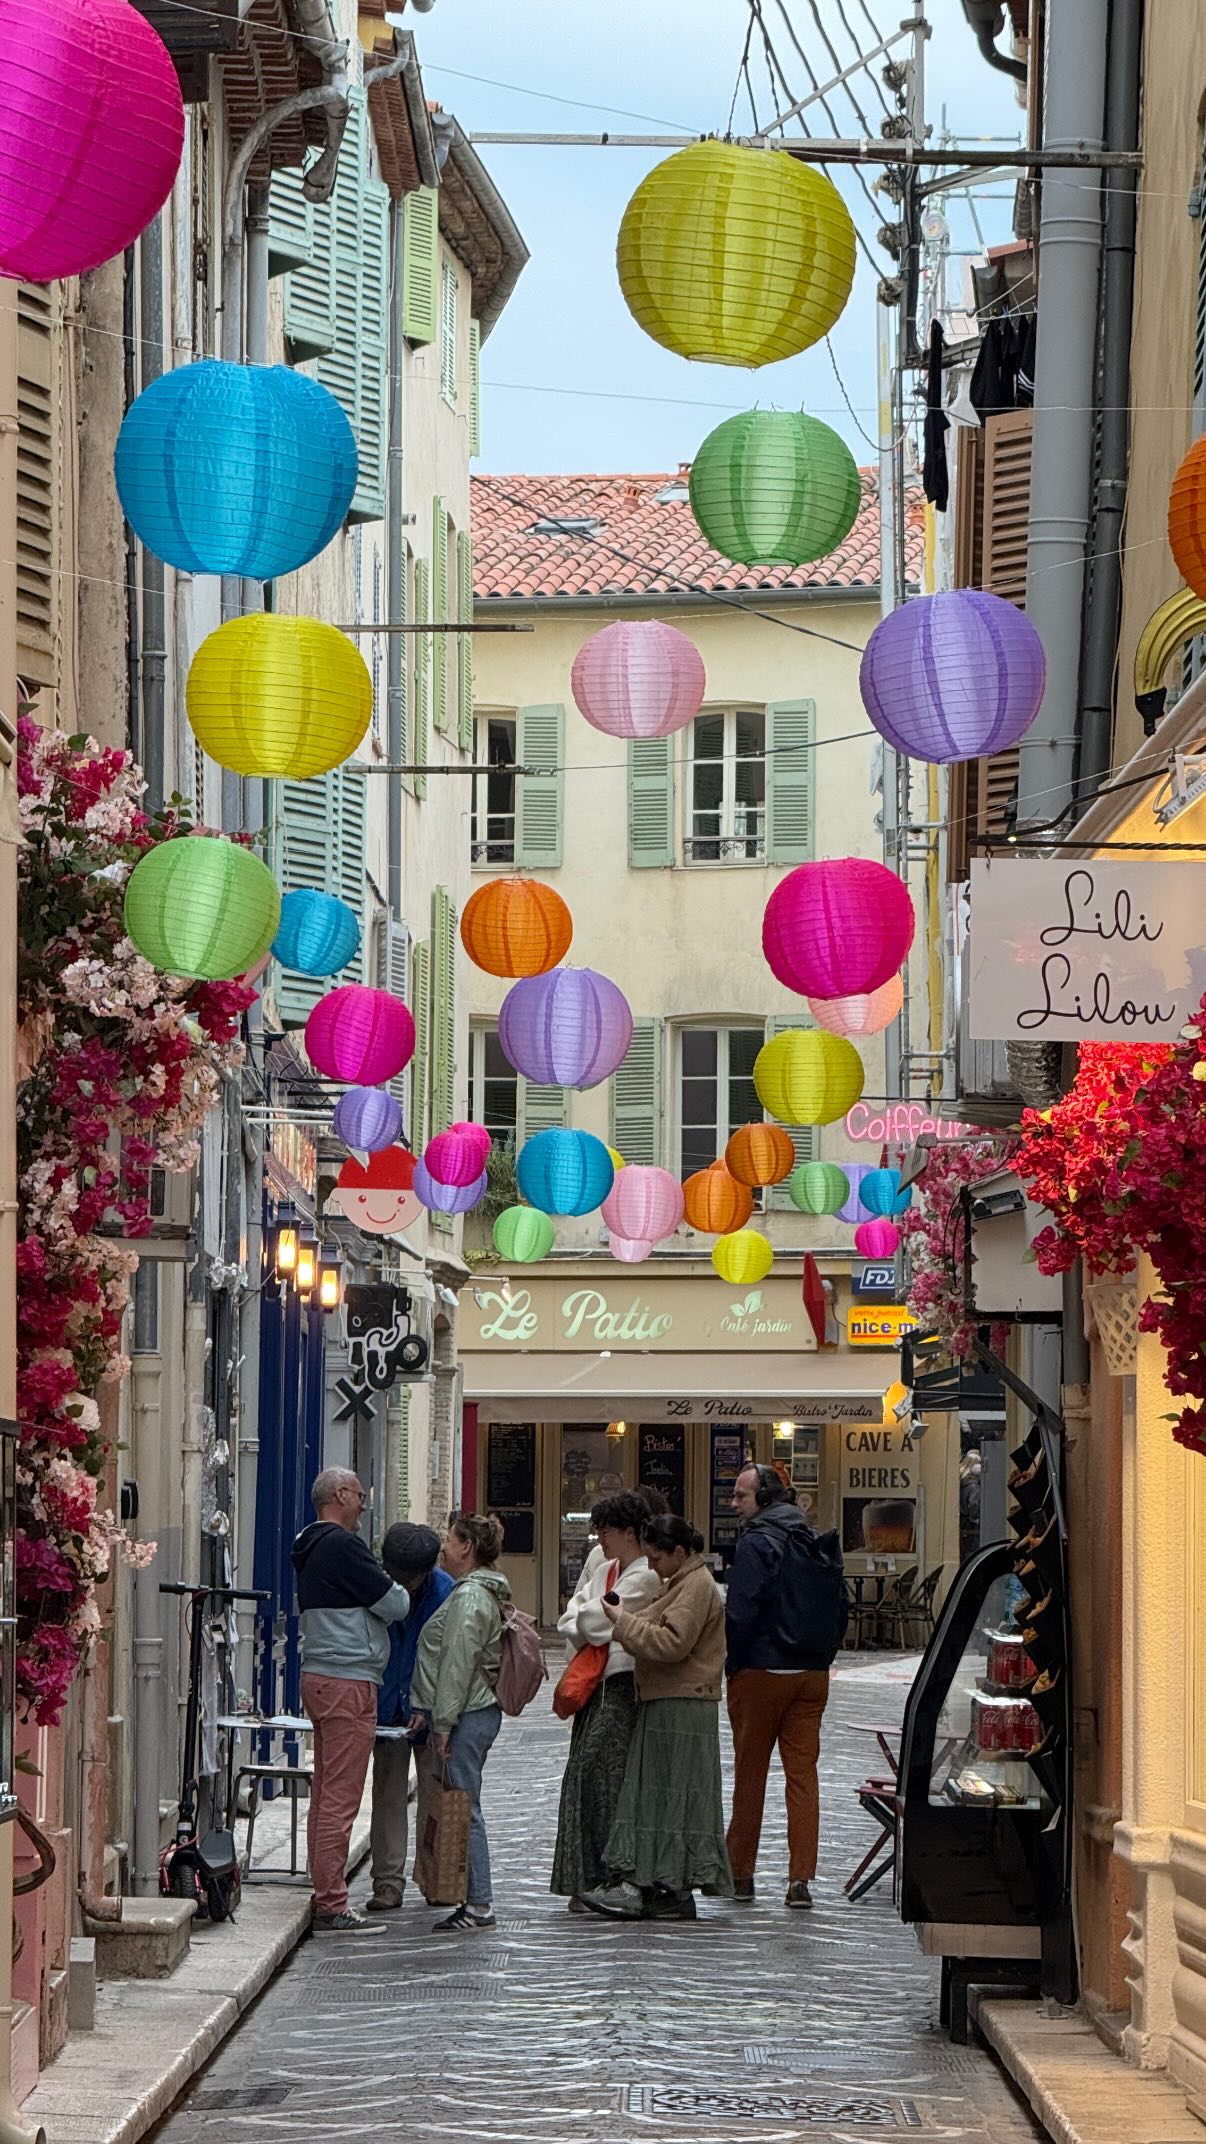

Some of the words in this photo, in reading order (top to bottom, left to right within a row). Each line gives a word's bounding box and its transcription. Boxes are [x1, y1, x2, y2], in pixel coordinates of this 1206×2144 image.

[1040, 870, 1164, 946] Lili
[1016, 953, 1176, 1029] Lilou
[846, 1103, 970, 1141] Coiffeur
[480, 1290, 538, 1340] Le
[562, 1290, 673, 1340] Patio
[751, 1318, 792, 1337] jardin
[667, 1400, 693, 1416] Le
[704, 1400, 752, 1416] Patio
[846, 1432, 893, 1452] CAVE
[848, 1467, 911, 1489] BIERES
